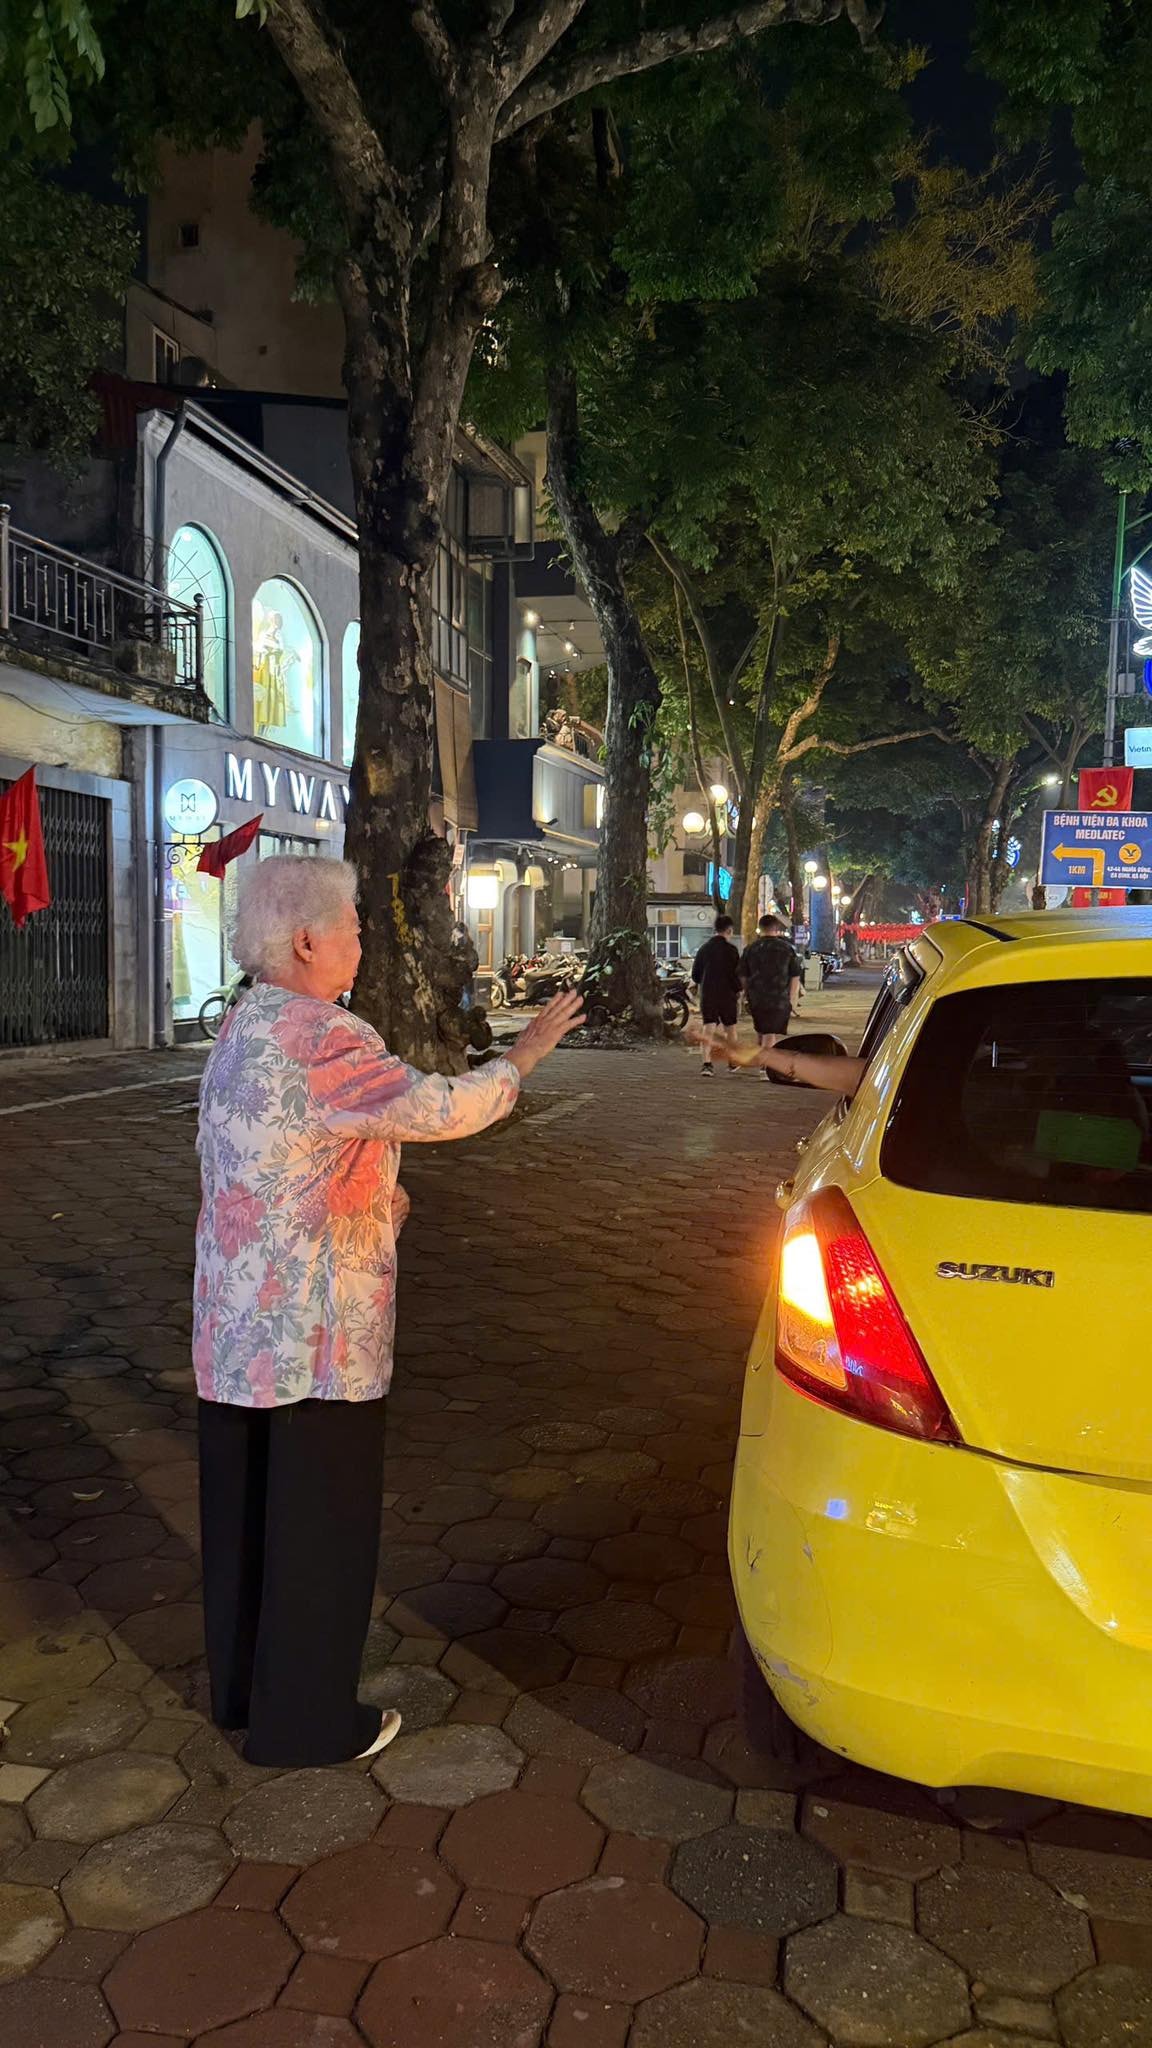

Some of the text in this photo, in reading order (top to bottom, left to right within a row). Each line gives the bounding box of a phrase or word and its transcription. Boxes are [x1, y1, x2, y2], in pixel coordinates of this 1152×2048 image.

[1053, 813, 1080, 828] BỆNH
[1082, 814, 1104, 828] VIỆN
[1121, 816, 1148, 828] KHOA
[1075, 829, 1126, 841] MEDLATEC
[936, 1261, 1055, 1288] SUZUKI
